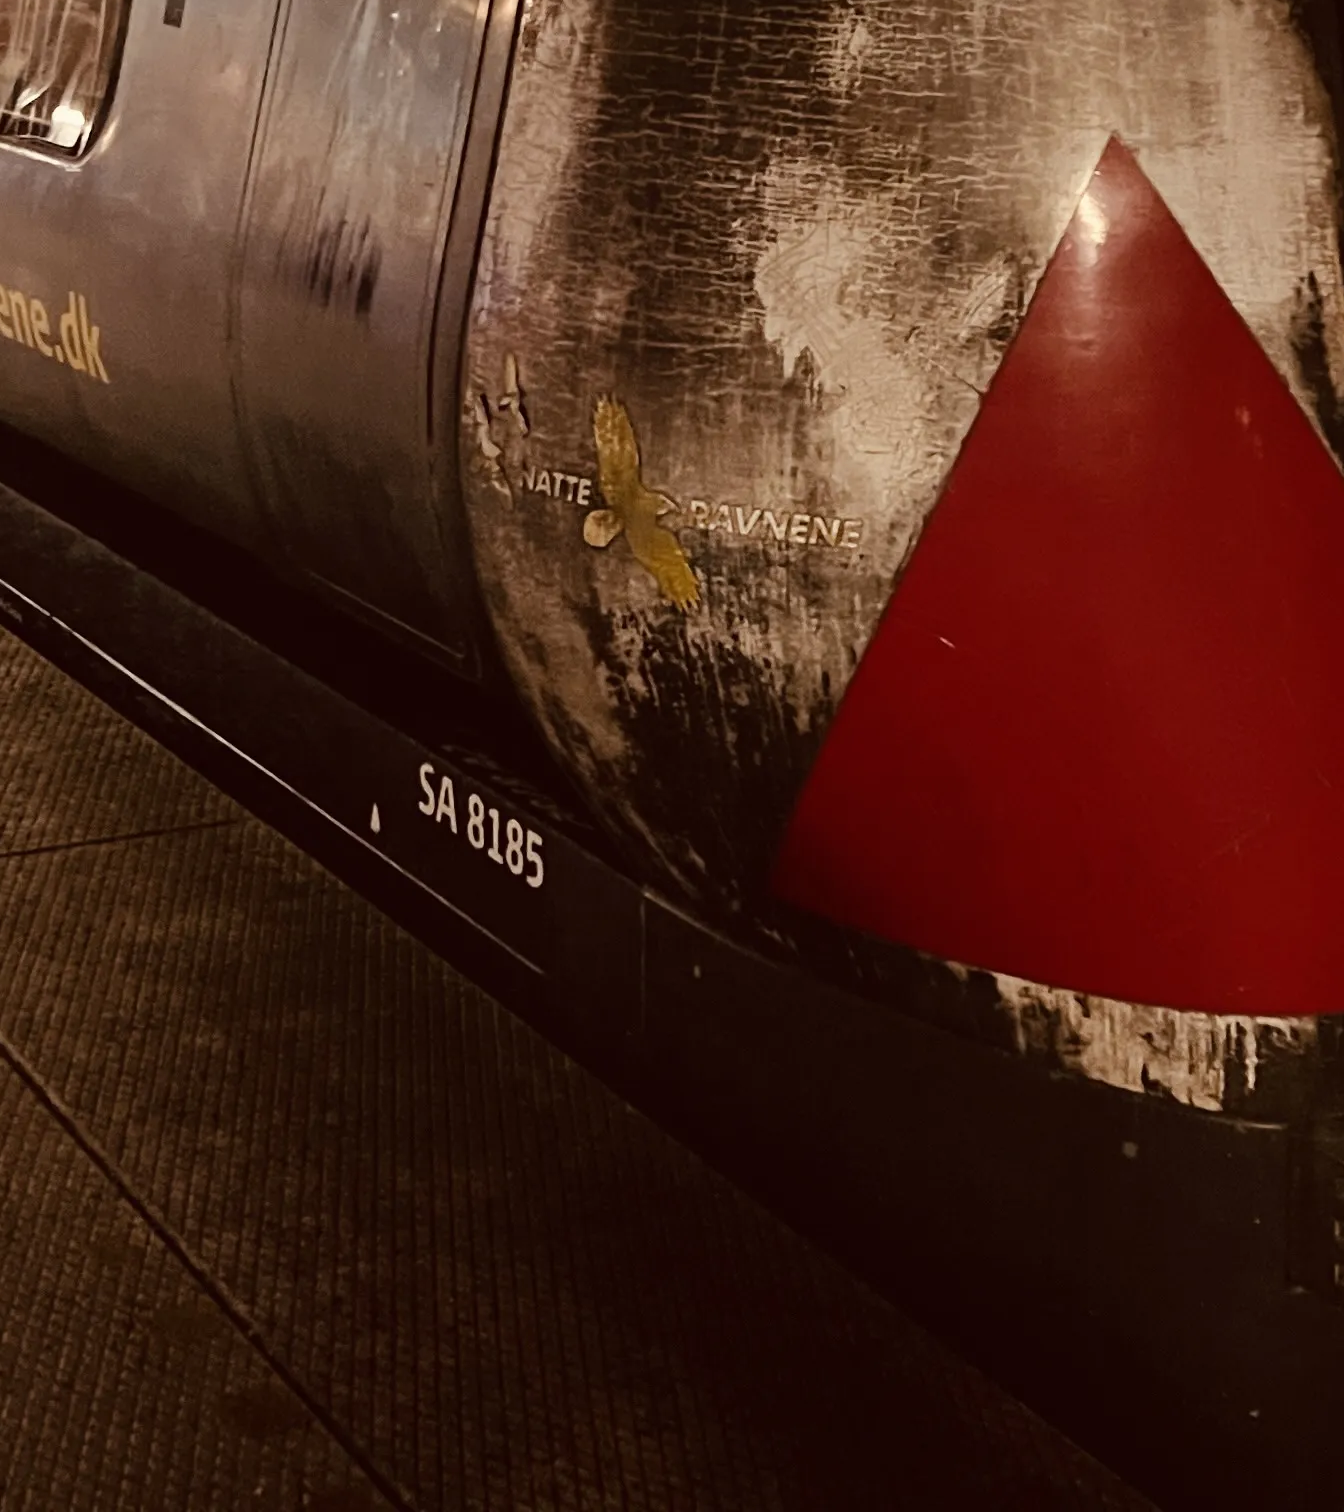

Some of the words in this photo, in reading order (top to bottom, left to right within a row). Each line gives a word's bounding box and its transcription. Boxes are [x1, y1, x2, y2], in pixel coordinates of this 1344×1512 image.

[520, 465, 593, 506] NATTE
[689, 499, 864, 548] RAVNENE
[418, 762, 457, 834] SA
[467, 793, 544, 888] 8185
